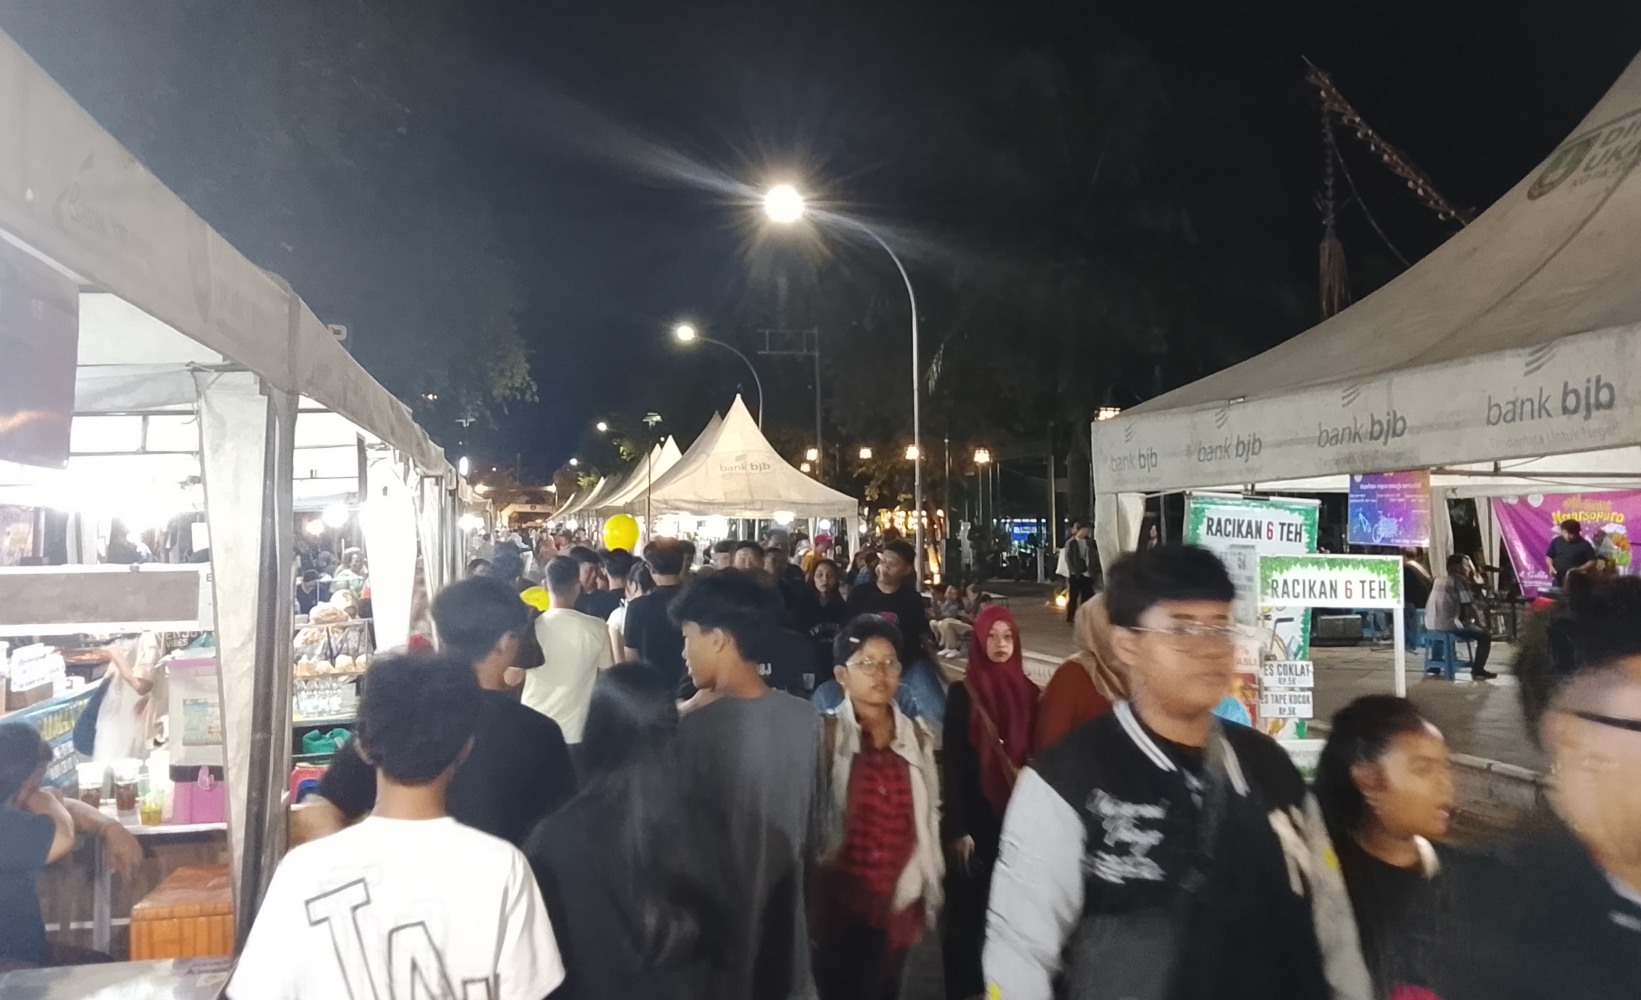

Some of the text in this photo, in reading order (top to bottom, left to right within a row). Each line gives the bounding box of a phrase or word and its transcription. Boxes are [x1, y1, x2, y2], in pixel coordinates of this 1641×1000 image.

[1485, 374, 1616, 427] bank bjb
[1317, 409, 1408, 448] bank bjb
[1110, 446, 1158, 473] bank bjb
[1197, 432, 1263, 464] bank bjb
[719, 462, 771, 472] bank bjb
[1206, 516, 1303, 543] RACIKAN 6 TEH
[1270, 579, 1388, 600] RACIKAN 6 TEH
[1264, 663, 1311, 677] ES COKLAT
[1271, 693, 1287, 705] TAPE
[1288, 693, 1311, 705] KOCOK
